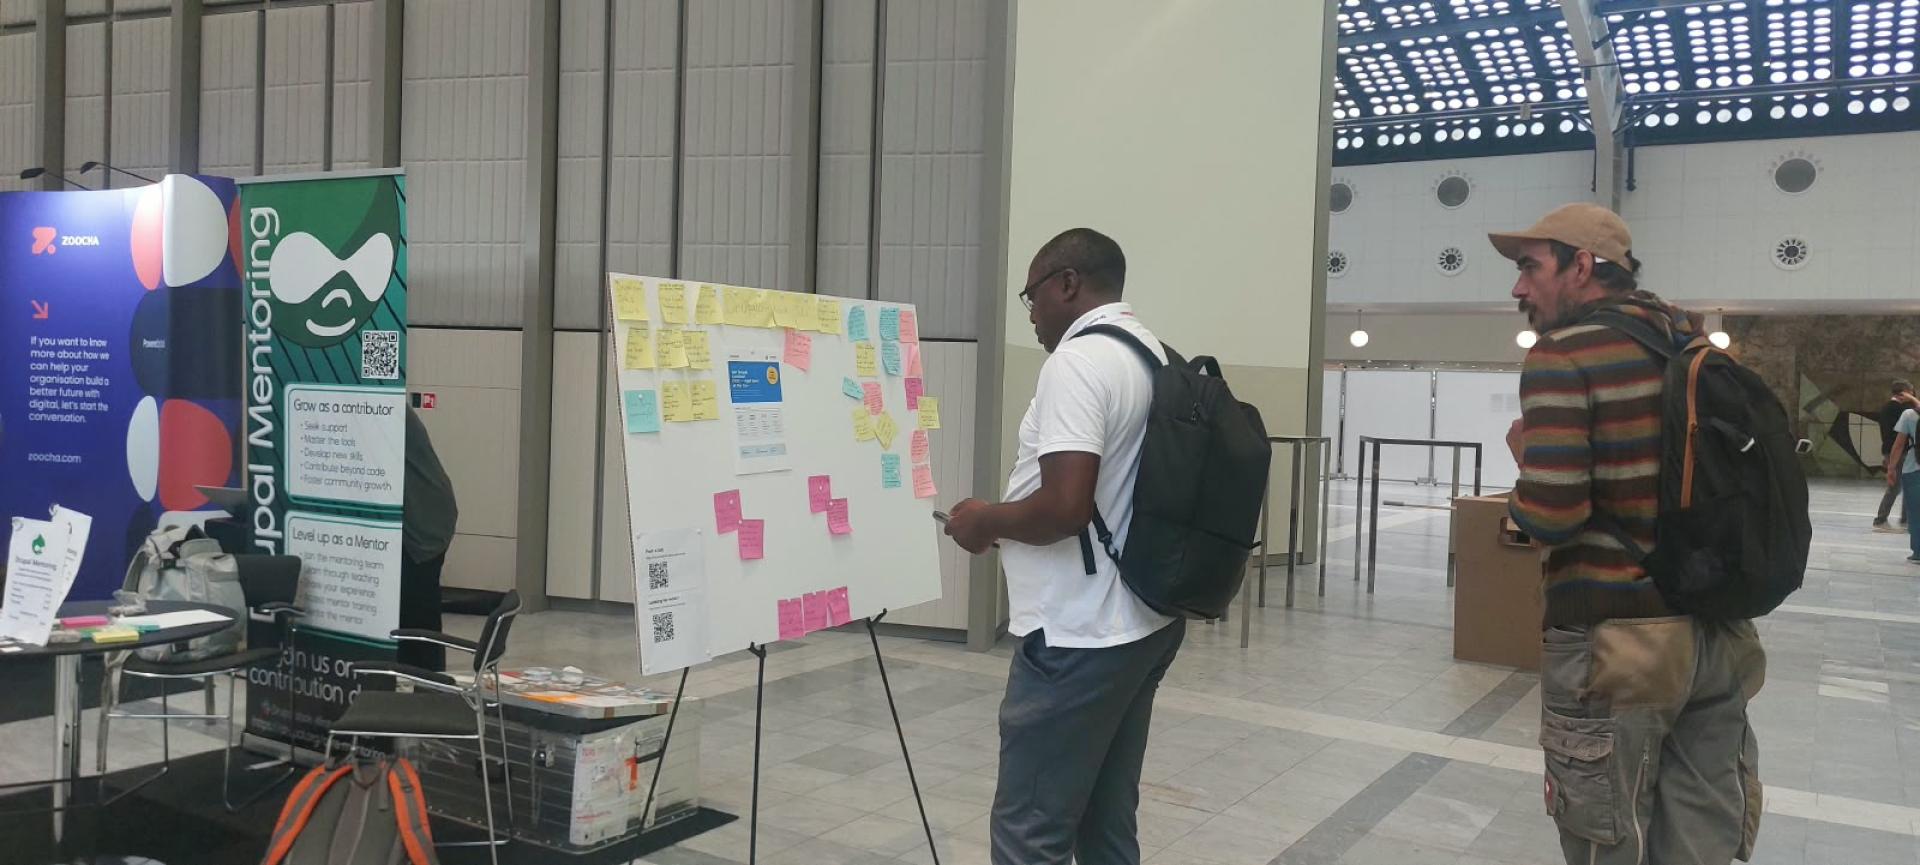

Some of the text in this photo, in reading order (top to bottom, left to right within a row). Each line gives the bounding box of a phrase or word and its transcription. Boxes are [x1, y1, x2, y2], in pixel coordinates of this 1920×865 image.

[61, 235, 100, 246] ZOOCHA
[246, 206, 280, 449] Mentoring
[30, 336, 108, 348] If you want to know
[30, 350, 55, 359] more
[57, 350, 82, 359] about
[83, 351, 98, 360] how
[30, 362, 89, 375] can help your
[30, 375, 85, 386] organisation
[85, 377, 104, 386] build
[29, 387, 100, 398] better future with
[29, 400, 109, 411] digital, let's start the
[293, 399, 394, 416] Grow as a contributor
[28, 413, 87, 423] conversation.
[327, 436, 339, 445] the
[28, 452, 82, 464] zoocha.com
[340, 464, 365, 477] beyond
[366, 467, 386, 477] code
[324, 477, 362, 490] community
[364, 481, 392, 492] growth
[292, 527, 389, 551] Level up as a Mentor
[328, 555, 364, 570] mentoring
[311, 654, 330, 674] us
